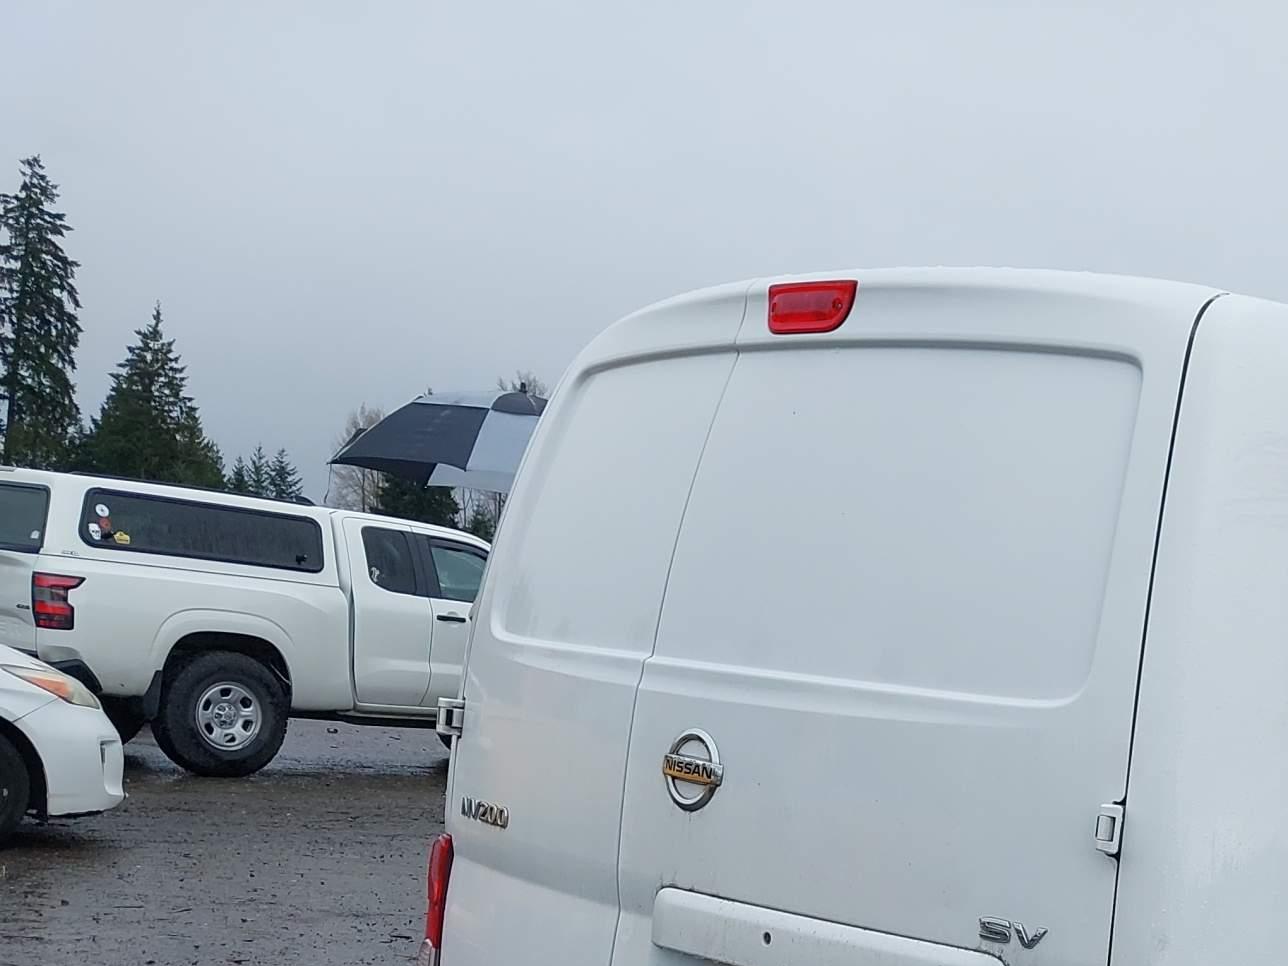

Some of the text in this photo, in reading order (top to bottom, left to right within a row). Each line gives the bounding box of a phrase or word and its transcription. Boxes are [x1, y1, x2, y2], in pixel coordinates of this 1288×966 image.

[665, 758, 712, 780] NISSAN
[461, 796, 509, 829] NV200
[979, 916, 1048, 949] SV
